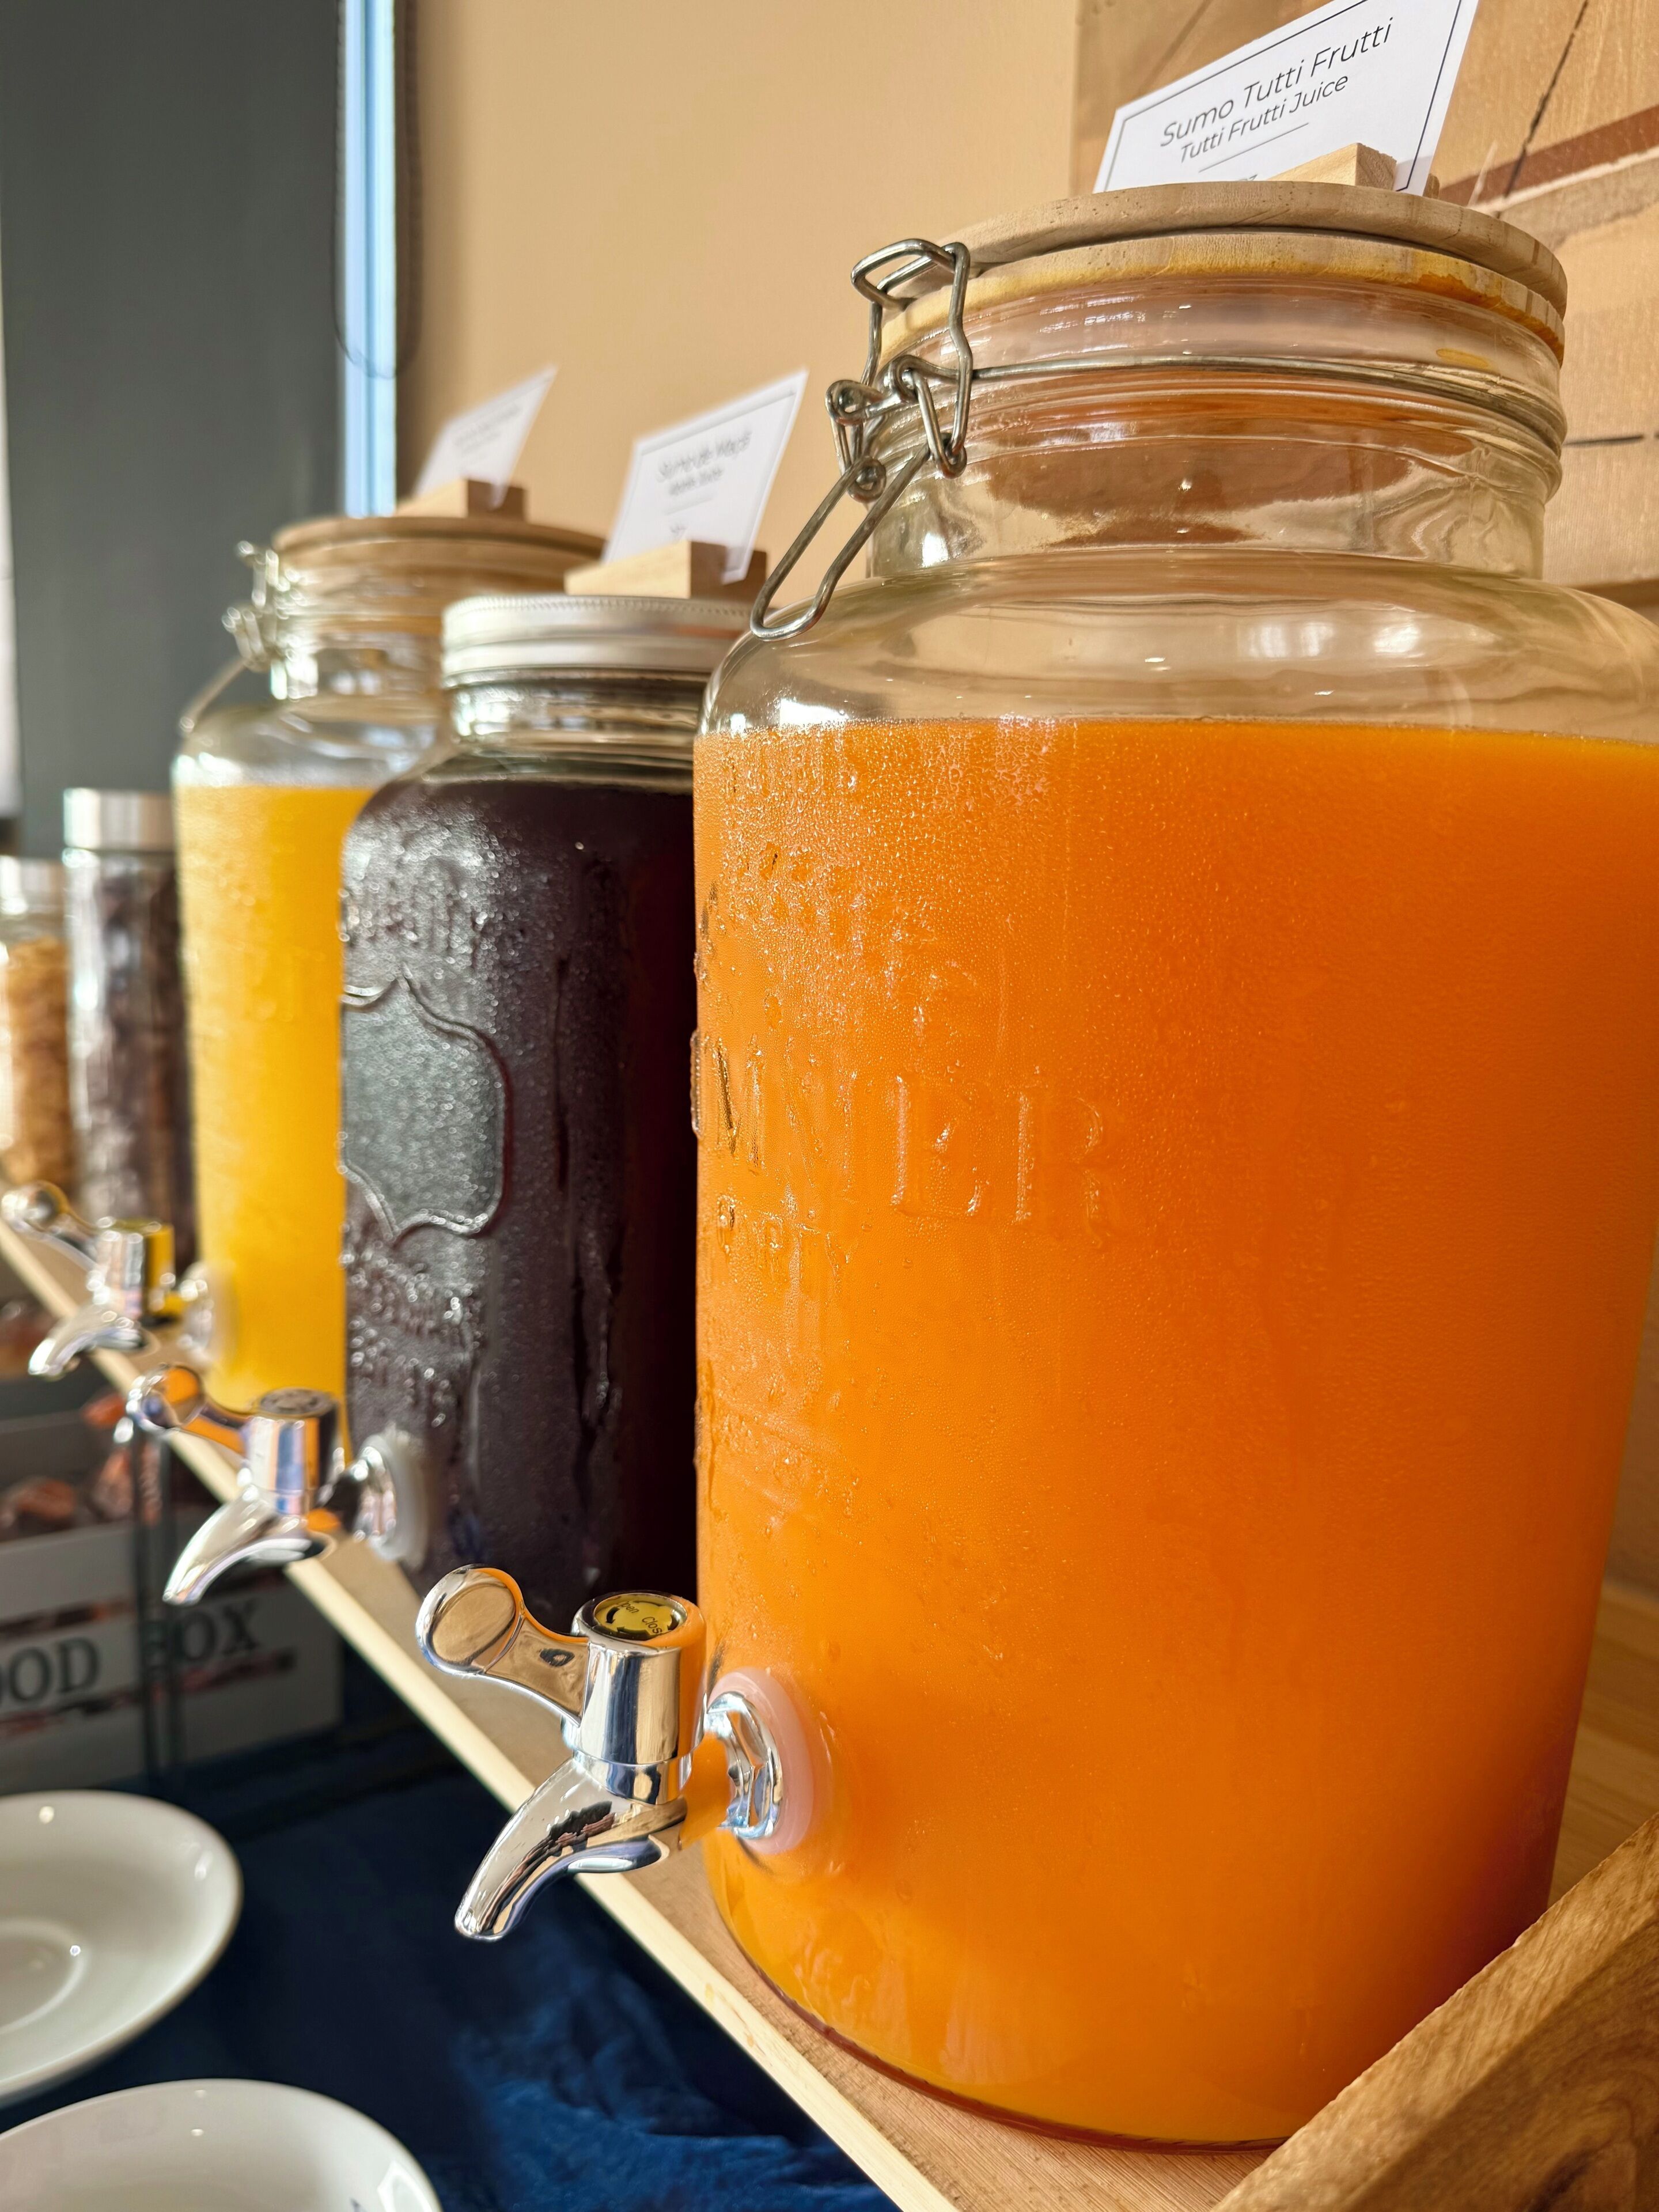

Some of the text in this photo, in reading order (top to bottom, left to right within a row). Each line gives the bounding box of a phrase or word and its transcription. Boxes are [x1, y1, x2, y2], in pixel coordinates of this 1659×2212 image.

[1160, 16, 1393, 147] Sumo Tutti Frutti
[1181, 75, 1349, 164] Tutti Frutti Juice
[618, 1601, 640, 1613] pen
[642, 1616, 663, 1635] Clos
[0, 1636, 100, 1705] OD
